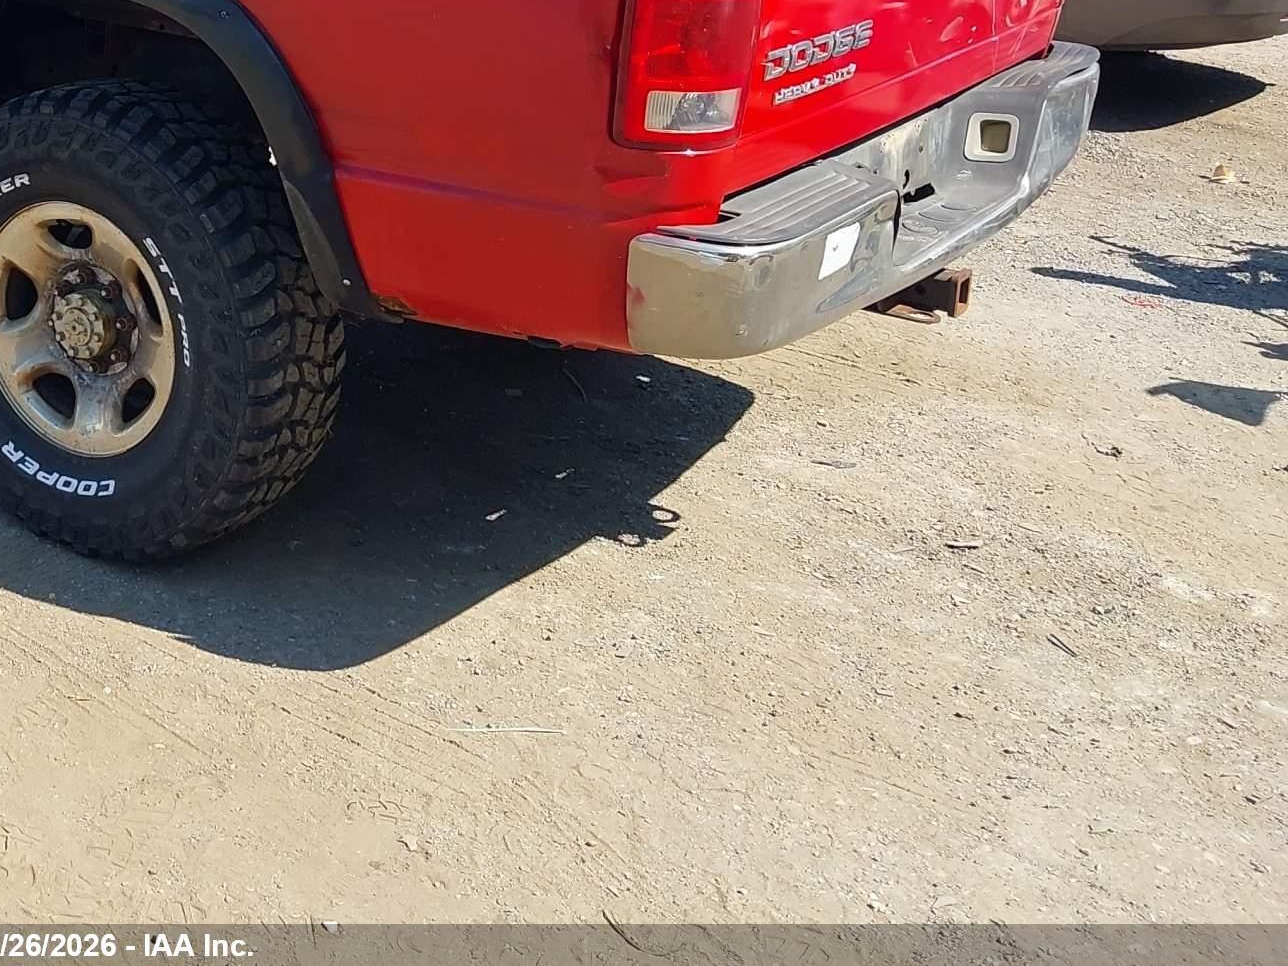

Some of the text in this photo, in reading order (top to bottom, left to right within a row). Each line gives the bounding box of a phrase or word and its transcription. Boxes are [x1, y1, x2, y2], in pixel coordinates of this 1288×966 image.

[763, 19, 875, 82] DODGE
[773, 63, 857, 106] HEAVY DUTY
[142, 236, 191, 368] STT PRO
[0, 439, 116, 497] COOPER
